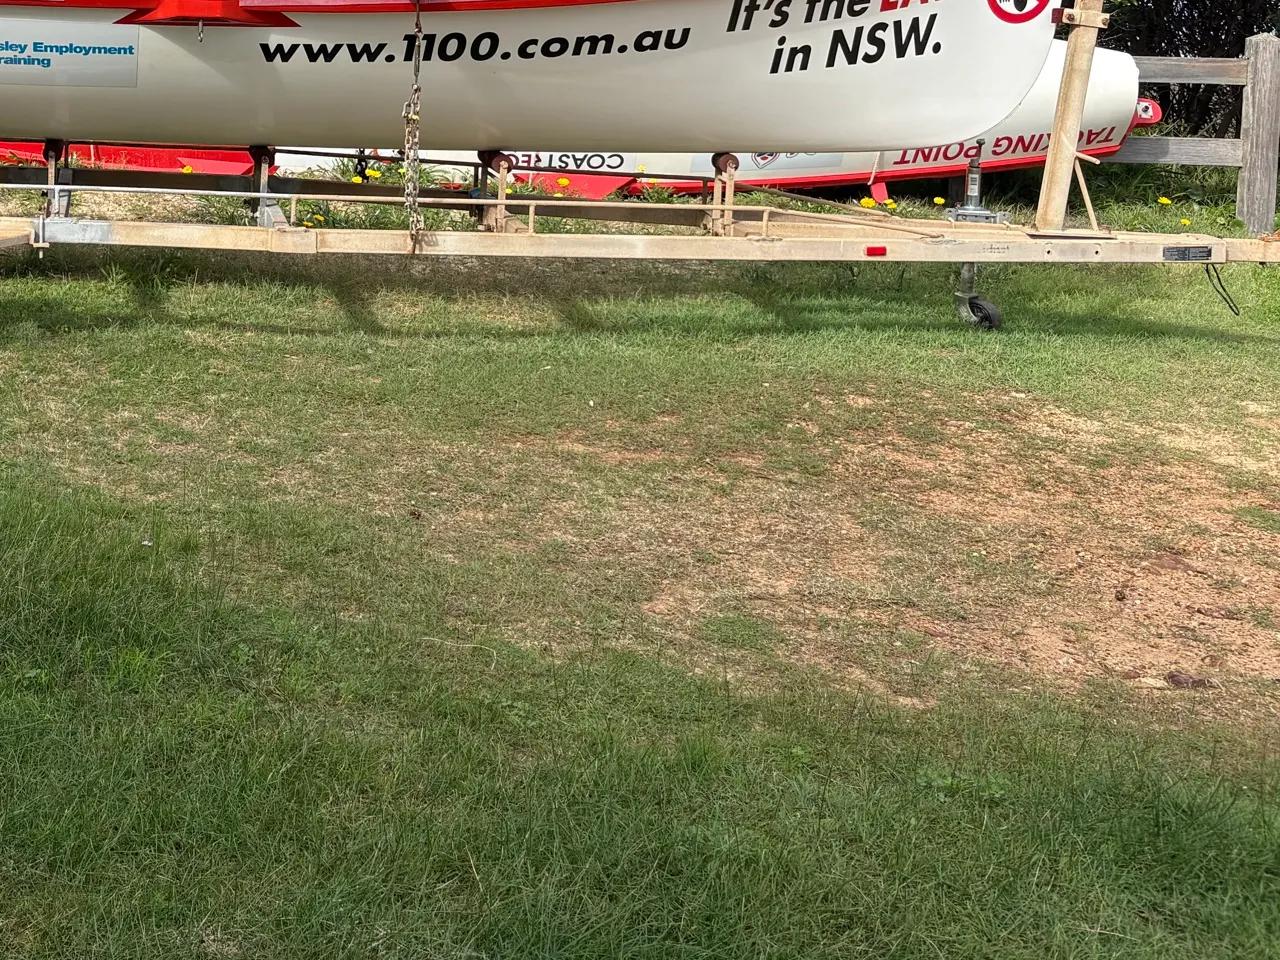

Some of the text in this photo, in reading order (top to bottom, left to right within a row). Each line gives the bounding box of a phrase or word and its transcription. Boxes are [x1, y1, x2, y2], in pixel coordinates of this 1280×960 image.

[32, 41, 135, 56] Employment
[259, 26, 692, 64] www.1100.com.au
[769, 13, 942, 74] in NSW.
